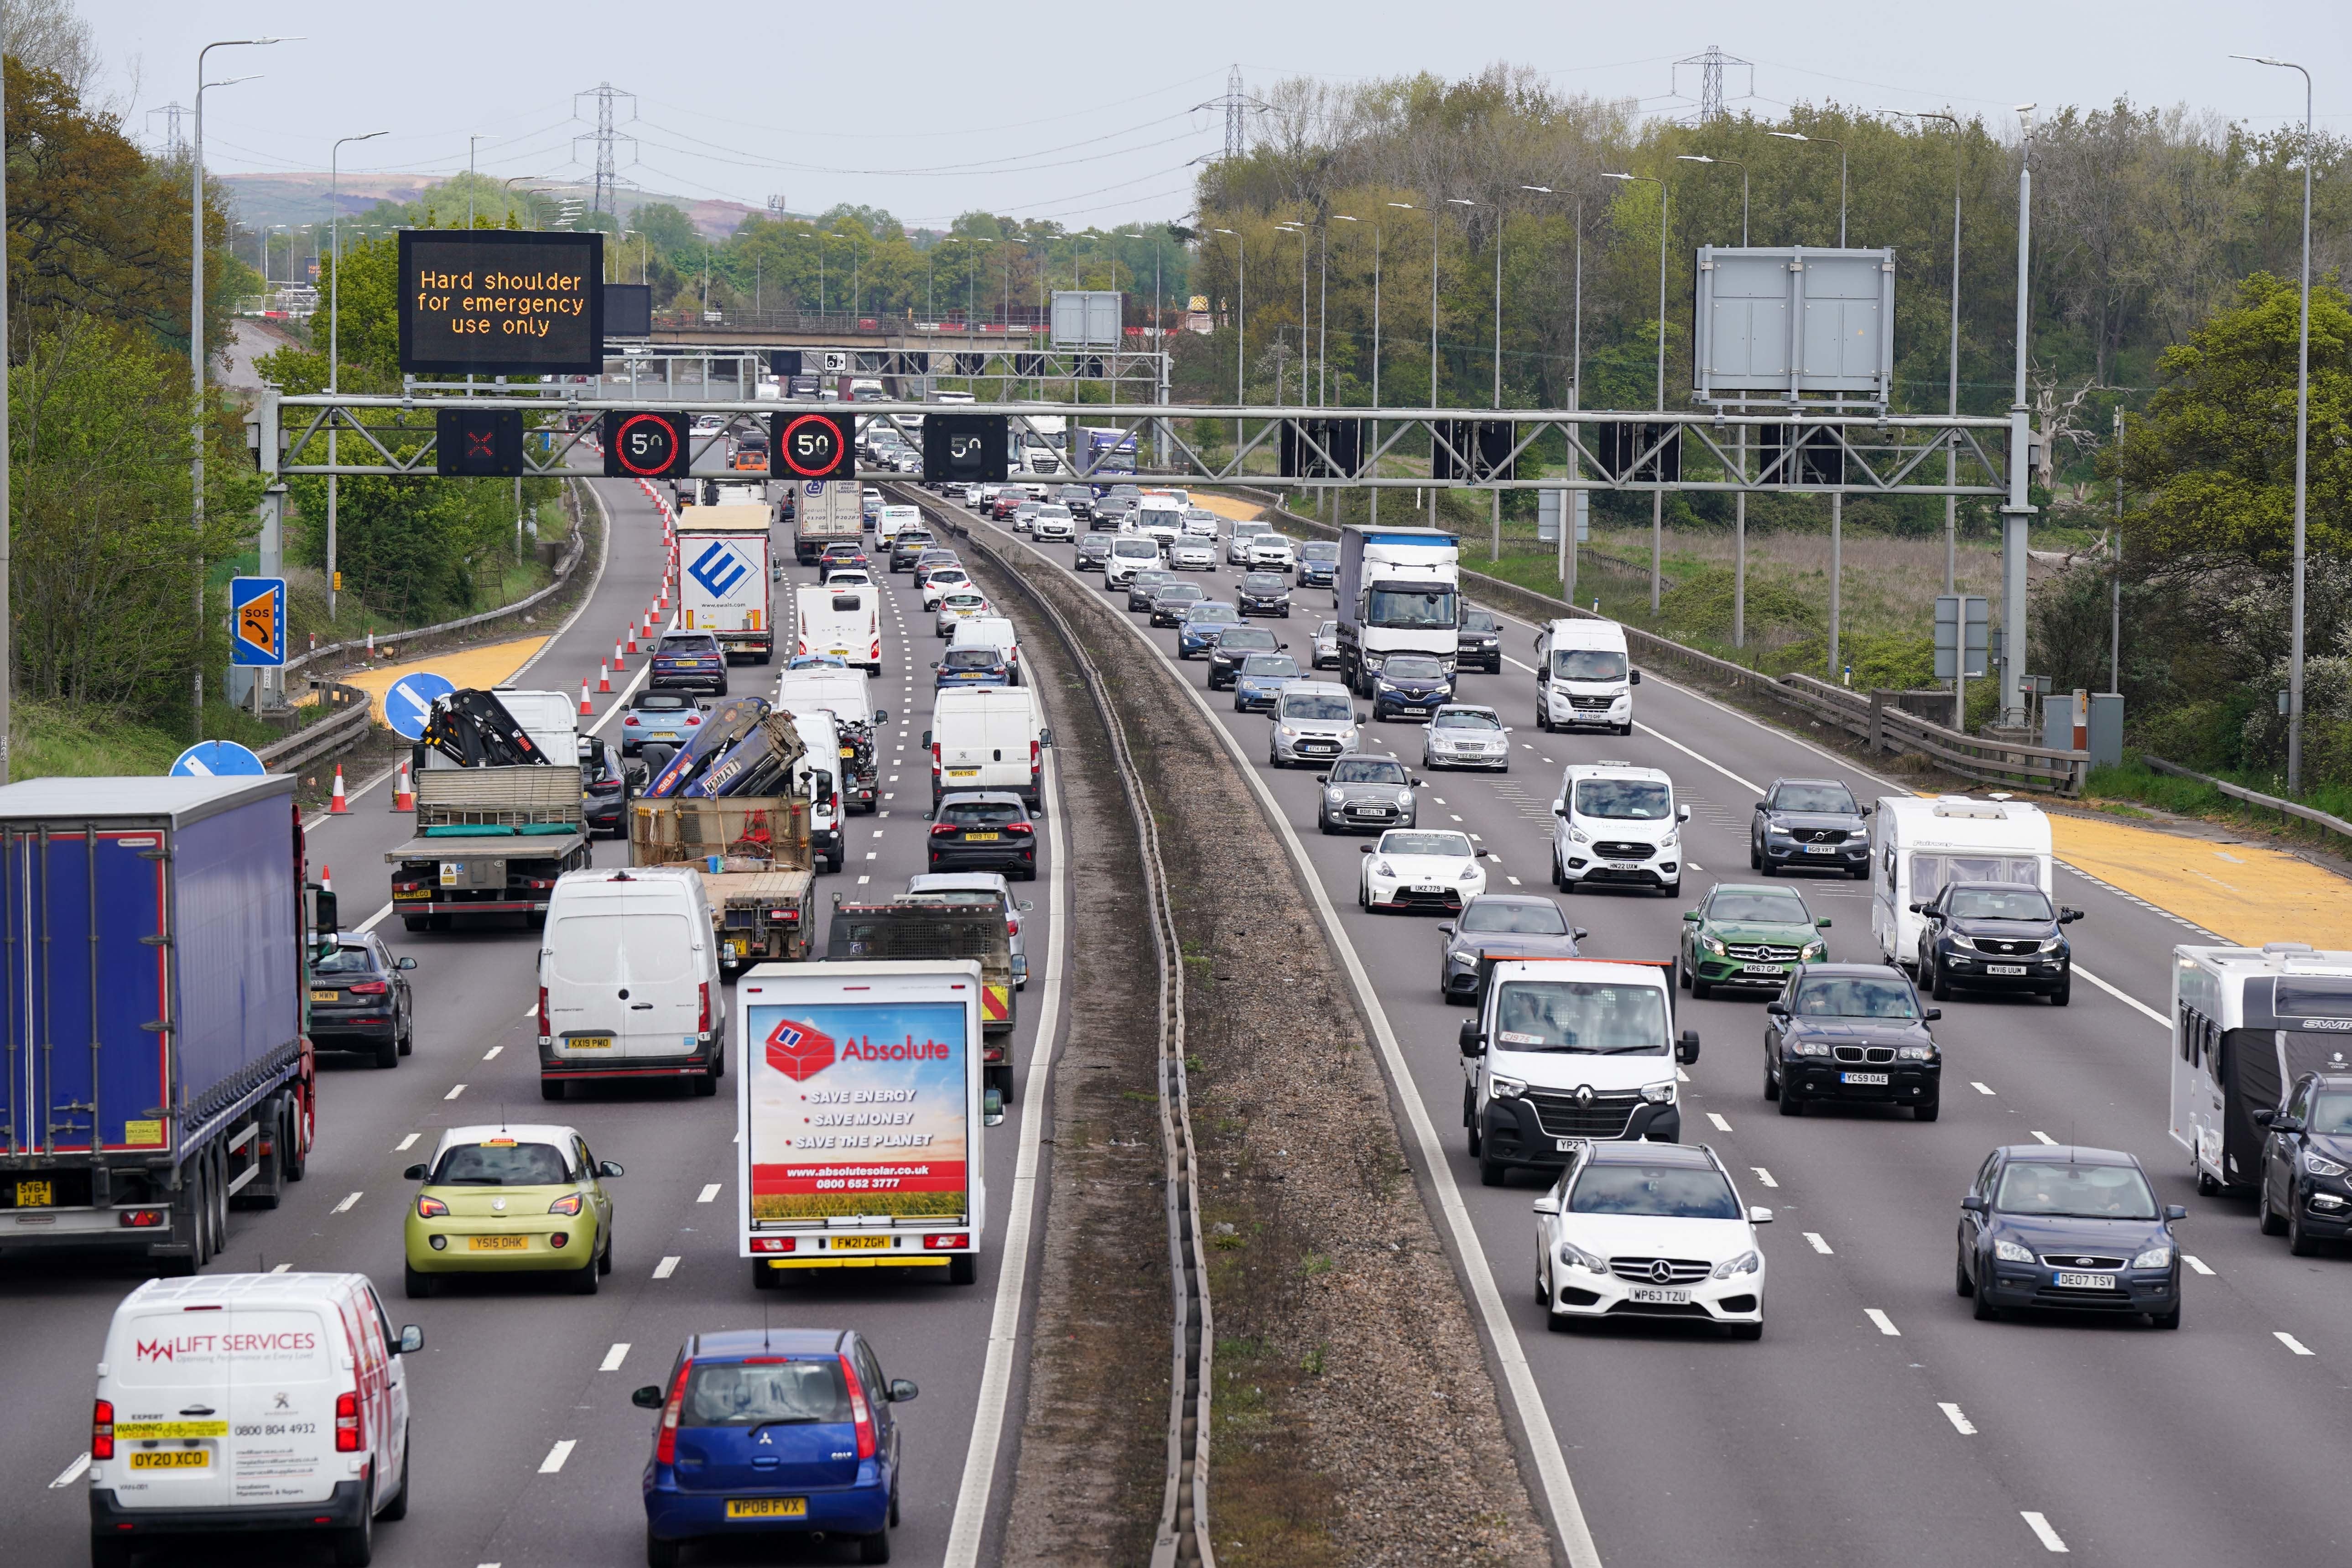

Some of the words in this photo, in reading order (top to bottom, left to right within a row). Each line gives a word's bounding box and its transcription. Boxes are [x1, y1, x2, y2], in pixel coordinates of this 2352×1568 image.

[421, 271, 472, 289] Hard
[485, 272, 581, 291] shoulder
[418, 293, 450, 311] for
[463, 297, 583, 316] emergency
[453, 318, 490, 333] use
[503, 317, 549, 337] only
[798, 434, 828, 456] 50
[245, 609, 269, 617] SOS
[1913, 839, 1953, 848] Fairway
[1746, 965, 1765, 973] KR67
[841, 1034, 949, 1061] Absolute
[1870, 1075, 1886, 1083] OAE
[811, 1091, 849, 1104] SAVE
[853, 1089, 916, 1102] ENERGY
[814, 1114, 853, 1125] SAVE
[856, 1112, 913, 1125] MONEY
[796, 1136, 835, 1148] SAVE
[839, 1135, 868, 1147] THE
[872, 1134, 933, 1146] PLANET
[787, 1166, 929, 1177] www.absolutesolar.co.uk
[21, 1183, 47, 1192] SV64
[817, 1179, 845, 1189] 0800
[848, 1179, 868, 1188] 652
[872, 1178, 900, 1188] 3777
[24, 1195, 44, 1205] HJE
[476, 1238, 499, 1247] YS15
[502, 1238, 522, 1247] OHK
[838, 1238, 861, 1248] FM21
[864, 1237, 884, 1247] ZGH
[2061, 1274, 2089, 1285] DE07
[2092, 1276, 2113, 1286] TSV
[1634, 1290, 1662, 1301] WP63
[1665, 1292, 1686, 1302] TZU
[177, 1335, 217, 1352] LIFT
[223, 1333, 315, 1351] SERVICES
[116, 1423, 163, 1432] WARNING
[235, 1425, 262, 1436] 0800
[265, 1424, 286, 1435] 804
[289, 1423, 316, 1434] 4932
[135, 1453, 171, 1466] OY20
[175, 1452, 202, 1465] XCO
[734, 1500, 769, 1515] WP08
[772, 1499, 799, 1512] FVX
